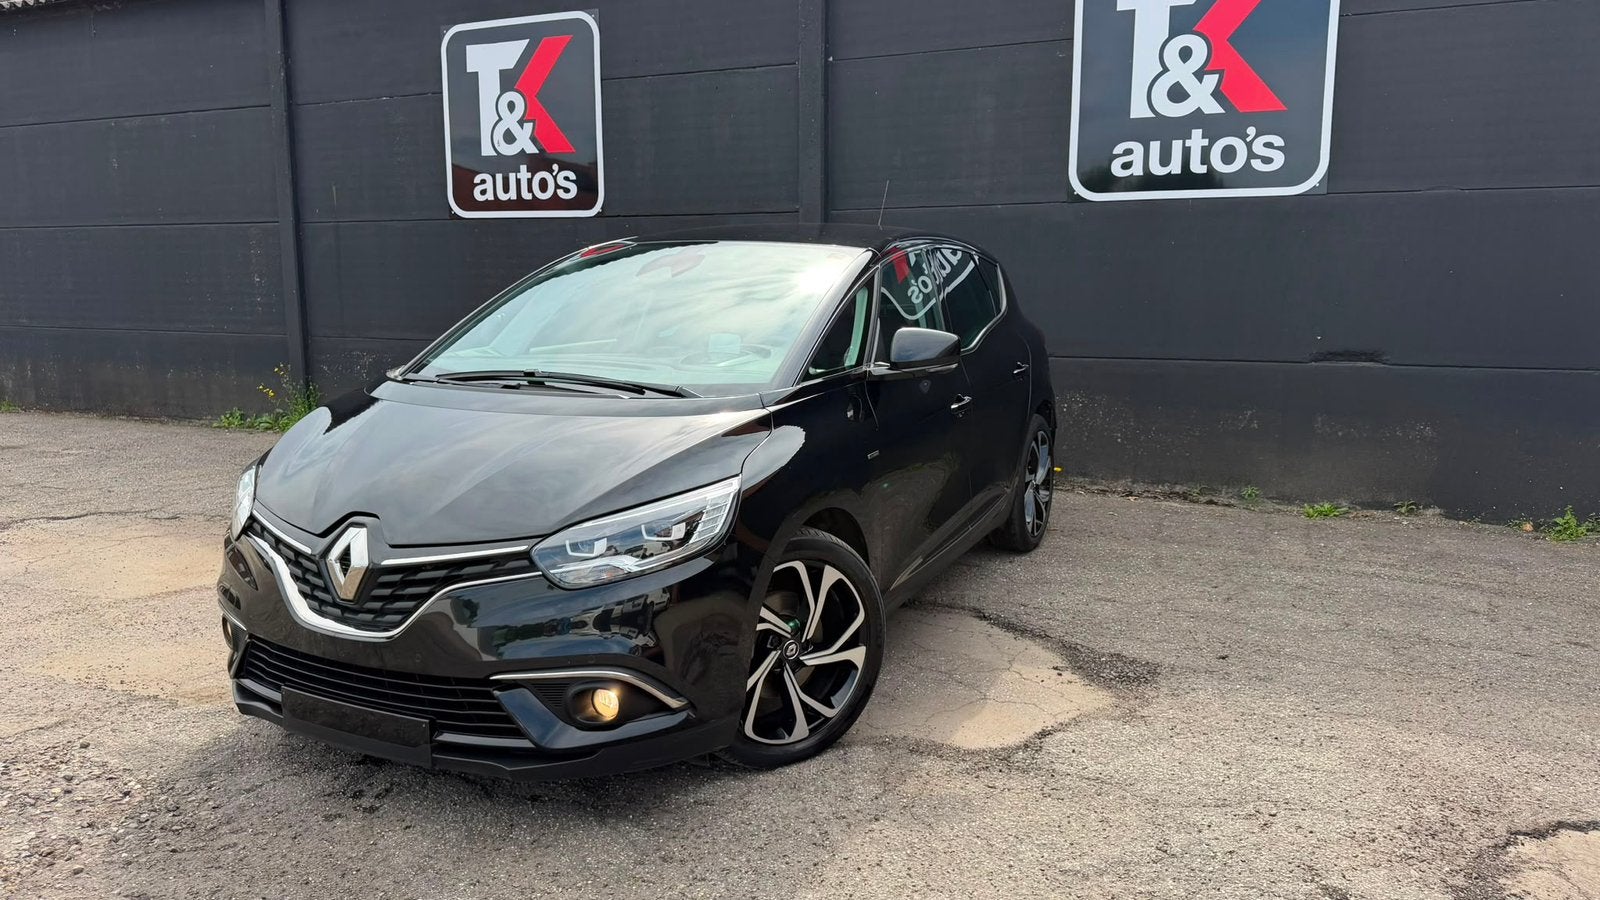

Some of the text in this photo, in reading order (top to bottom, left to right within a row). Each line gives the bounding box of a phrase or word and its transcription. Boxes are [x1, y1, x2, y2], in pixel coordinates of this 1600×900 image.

[466, 34, 576, 156] T&K
[1116, 0, 1289, 119] T&K
[473, 163, 578, 202] auto's
[1110, 126, 1286, 178] auto's
